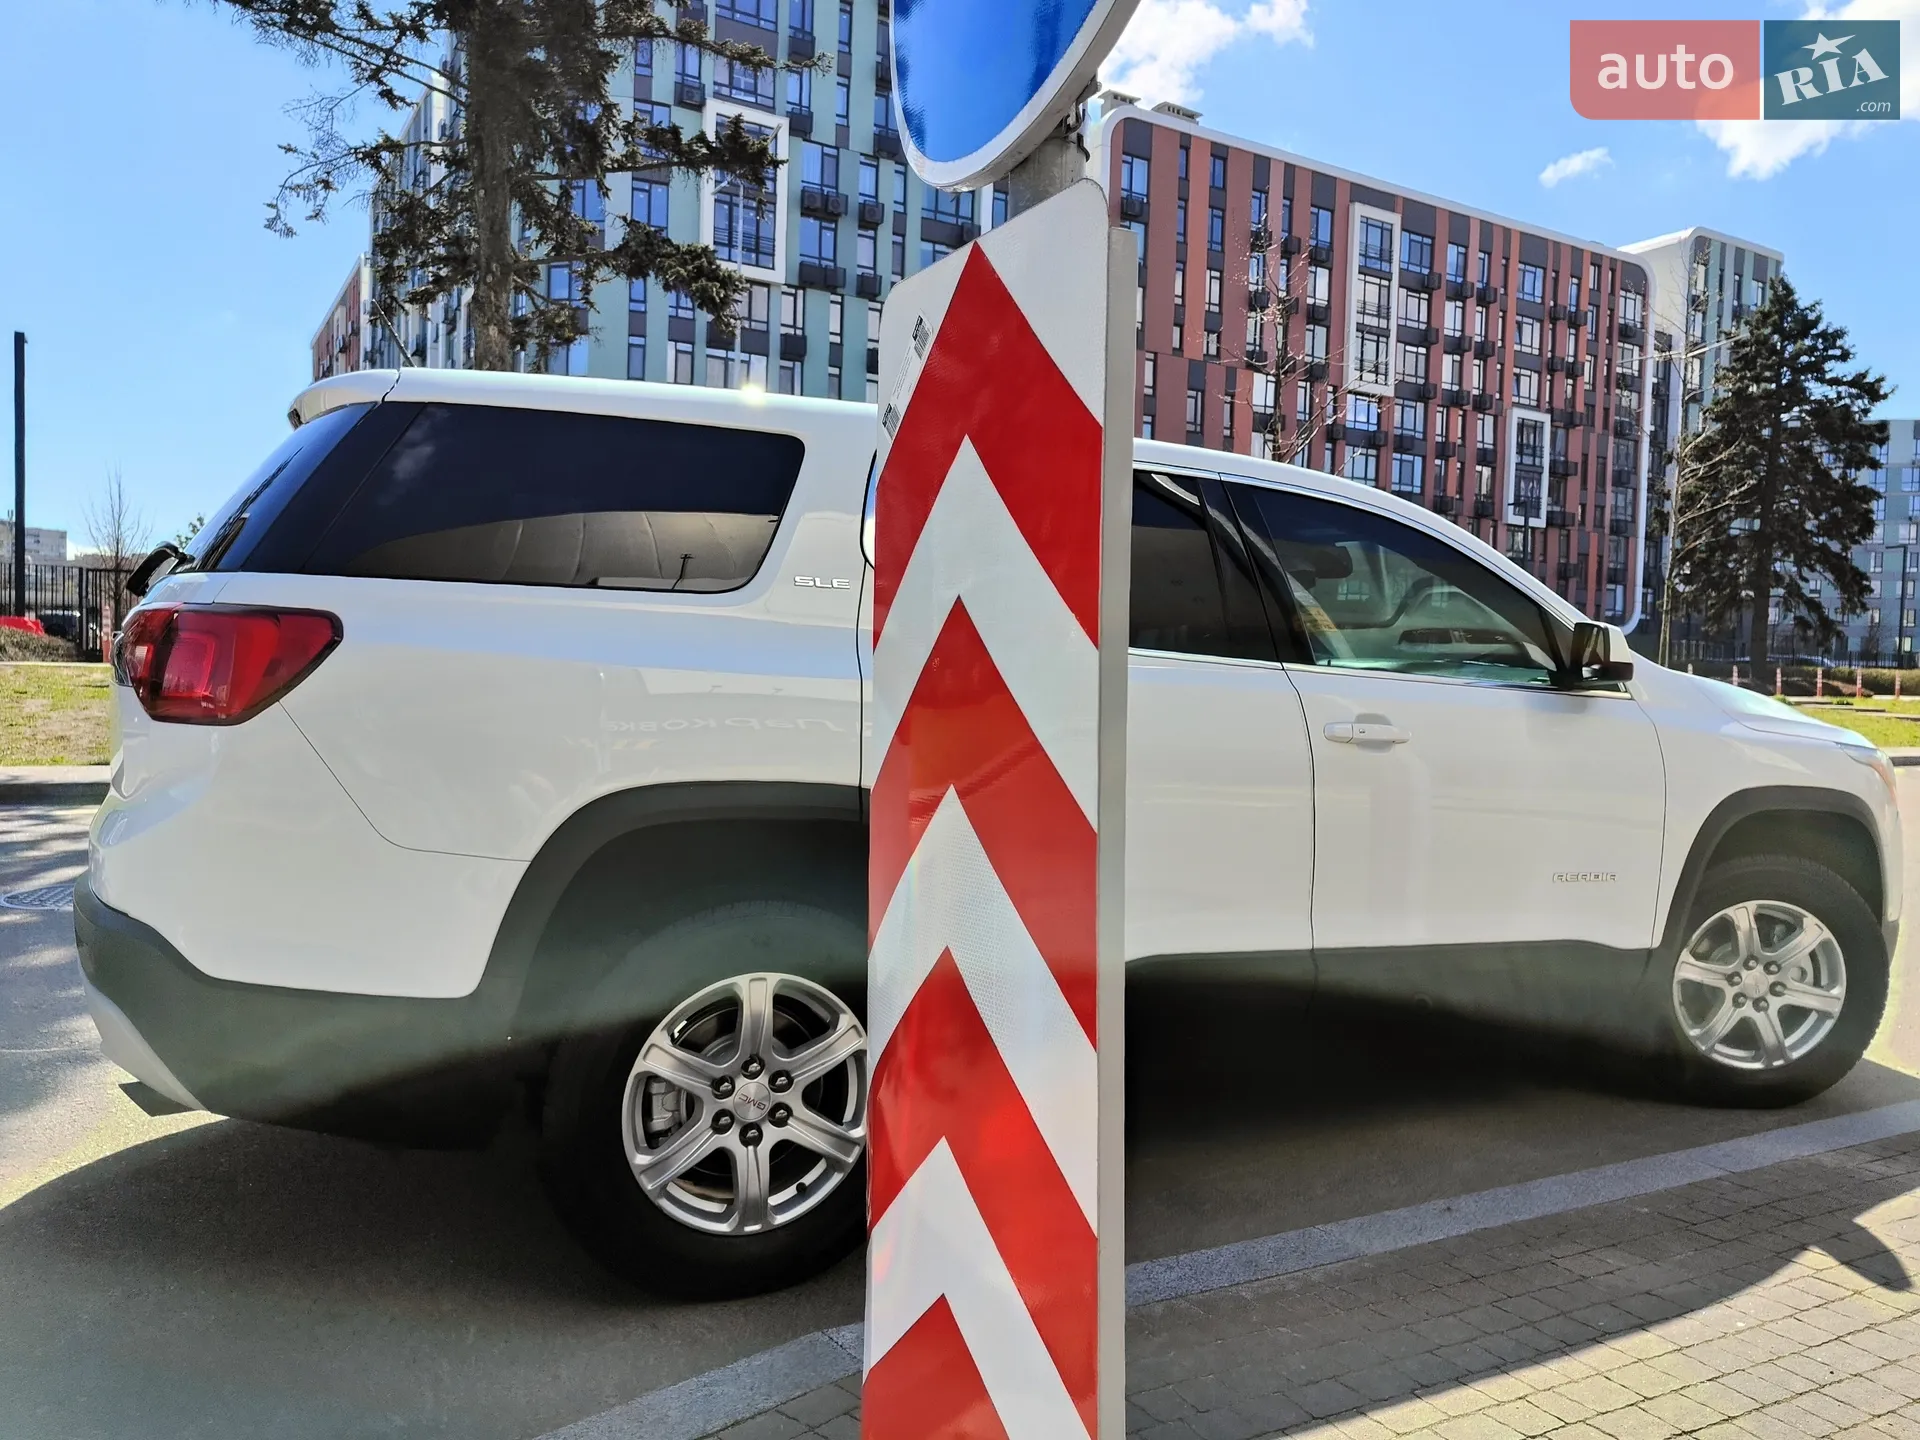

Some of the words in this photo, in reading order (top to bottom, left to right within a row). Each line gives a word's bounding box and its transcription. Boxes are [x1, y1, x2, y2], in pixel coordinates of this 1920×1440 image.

[794, 575, 850, 589] SLE
[1552, 871, 1618, 883] ACADIA
[738, 1092, 766, 1111] GMC
